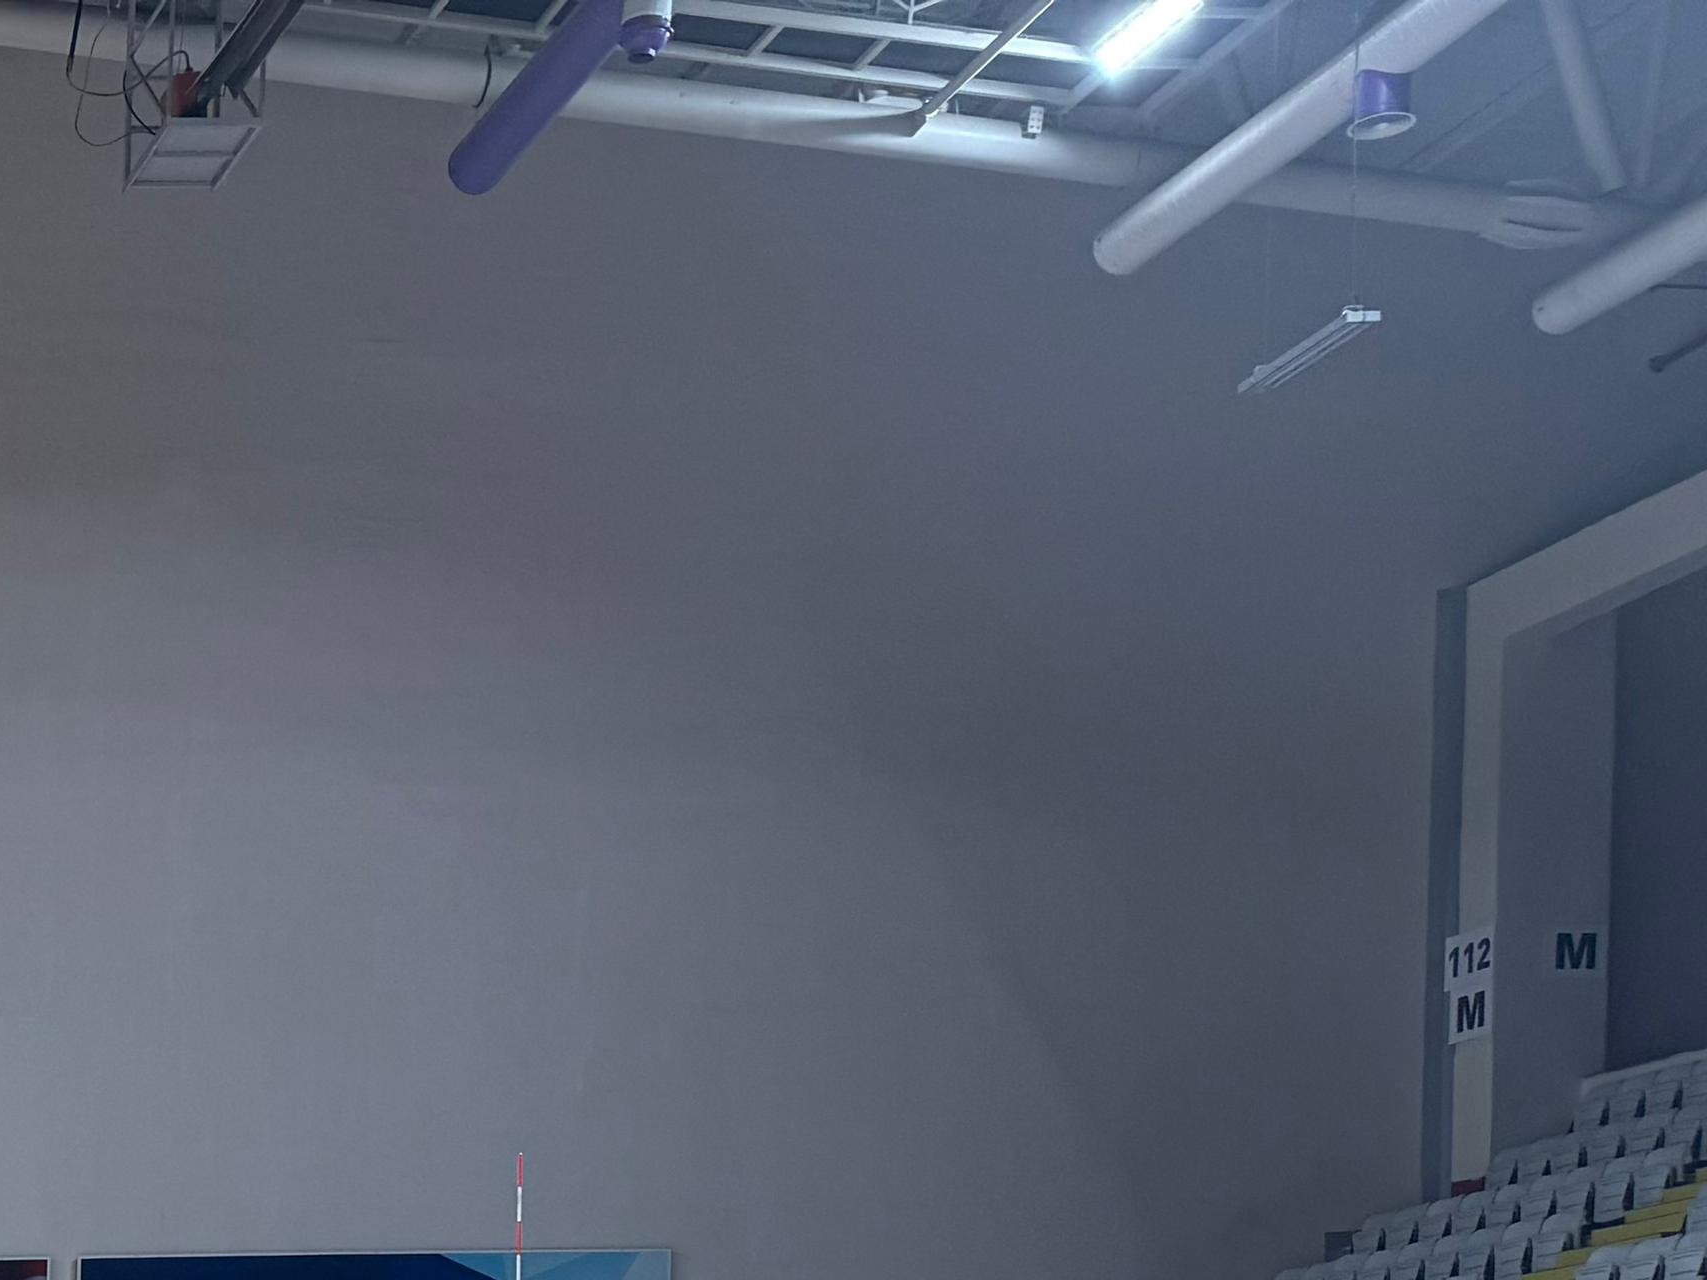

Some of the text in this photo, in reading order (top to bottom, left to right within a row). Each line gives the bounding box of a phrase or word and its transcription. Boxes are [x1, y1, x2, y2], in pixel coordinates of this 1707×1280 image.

[1448, 937, 1491, 978] 112
[1555, 932, 1596, 970] M
[1457, 990, 1485, 1034] M
